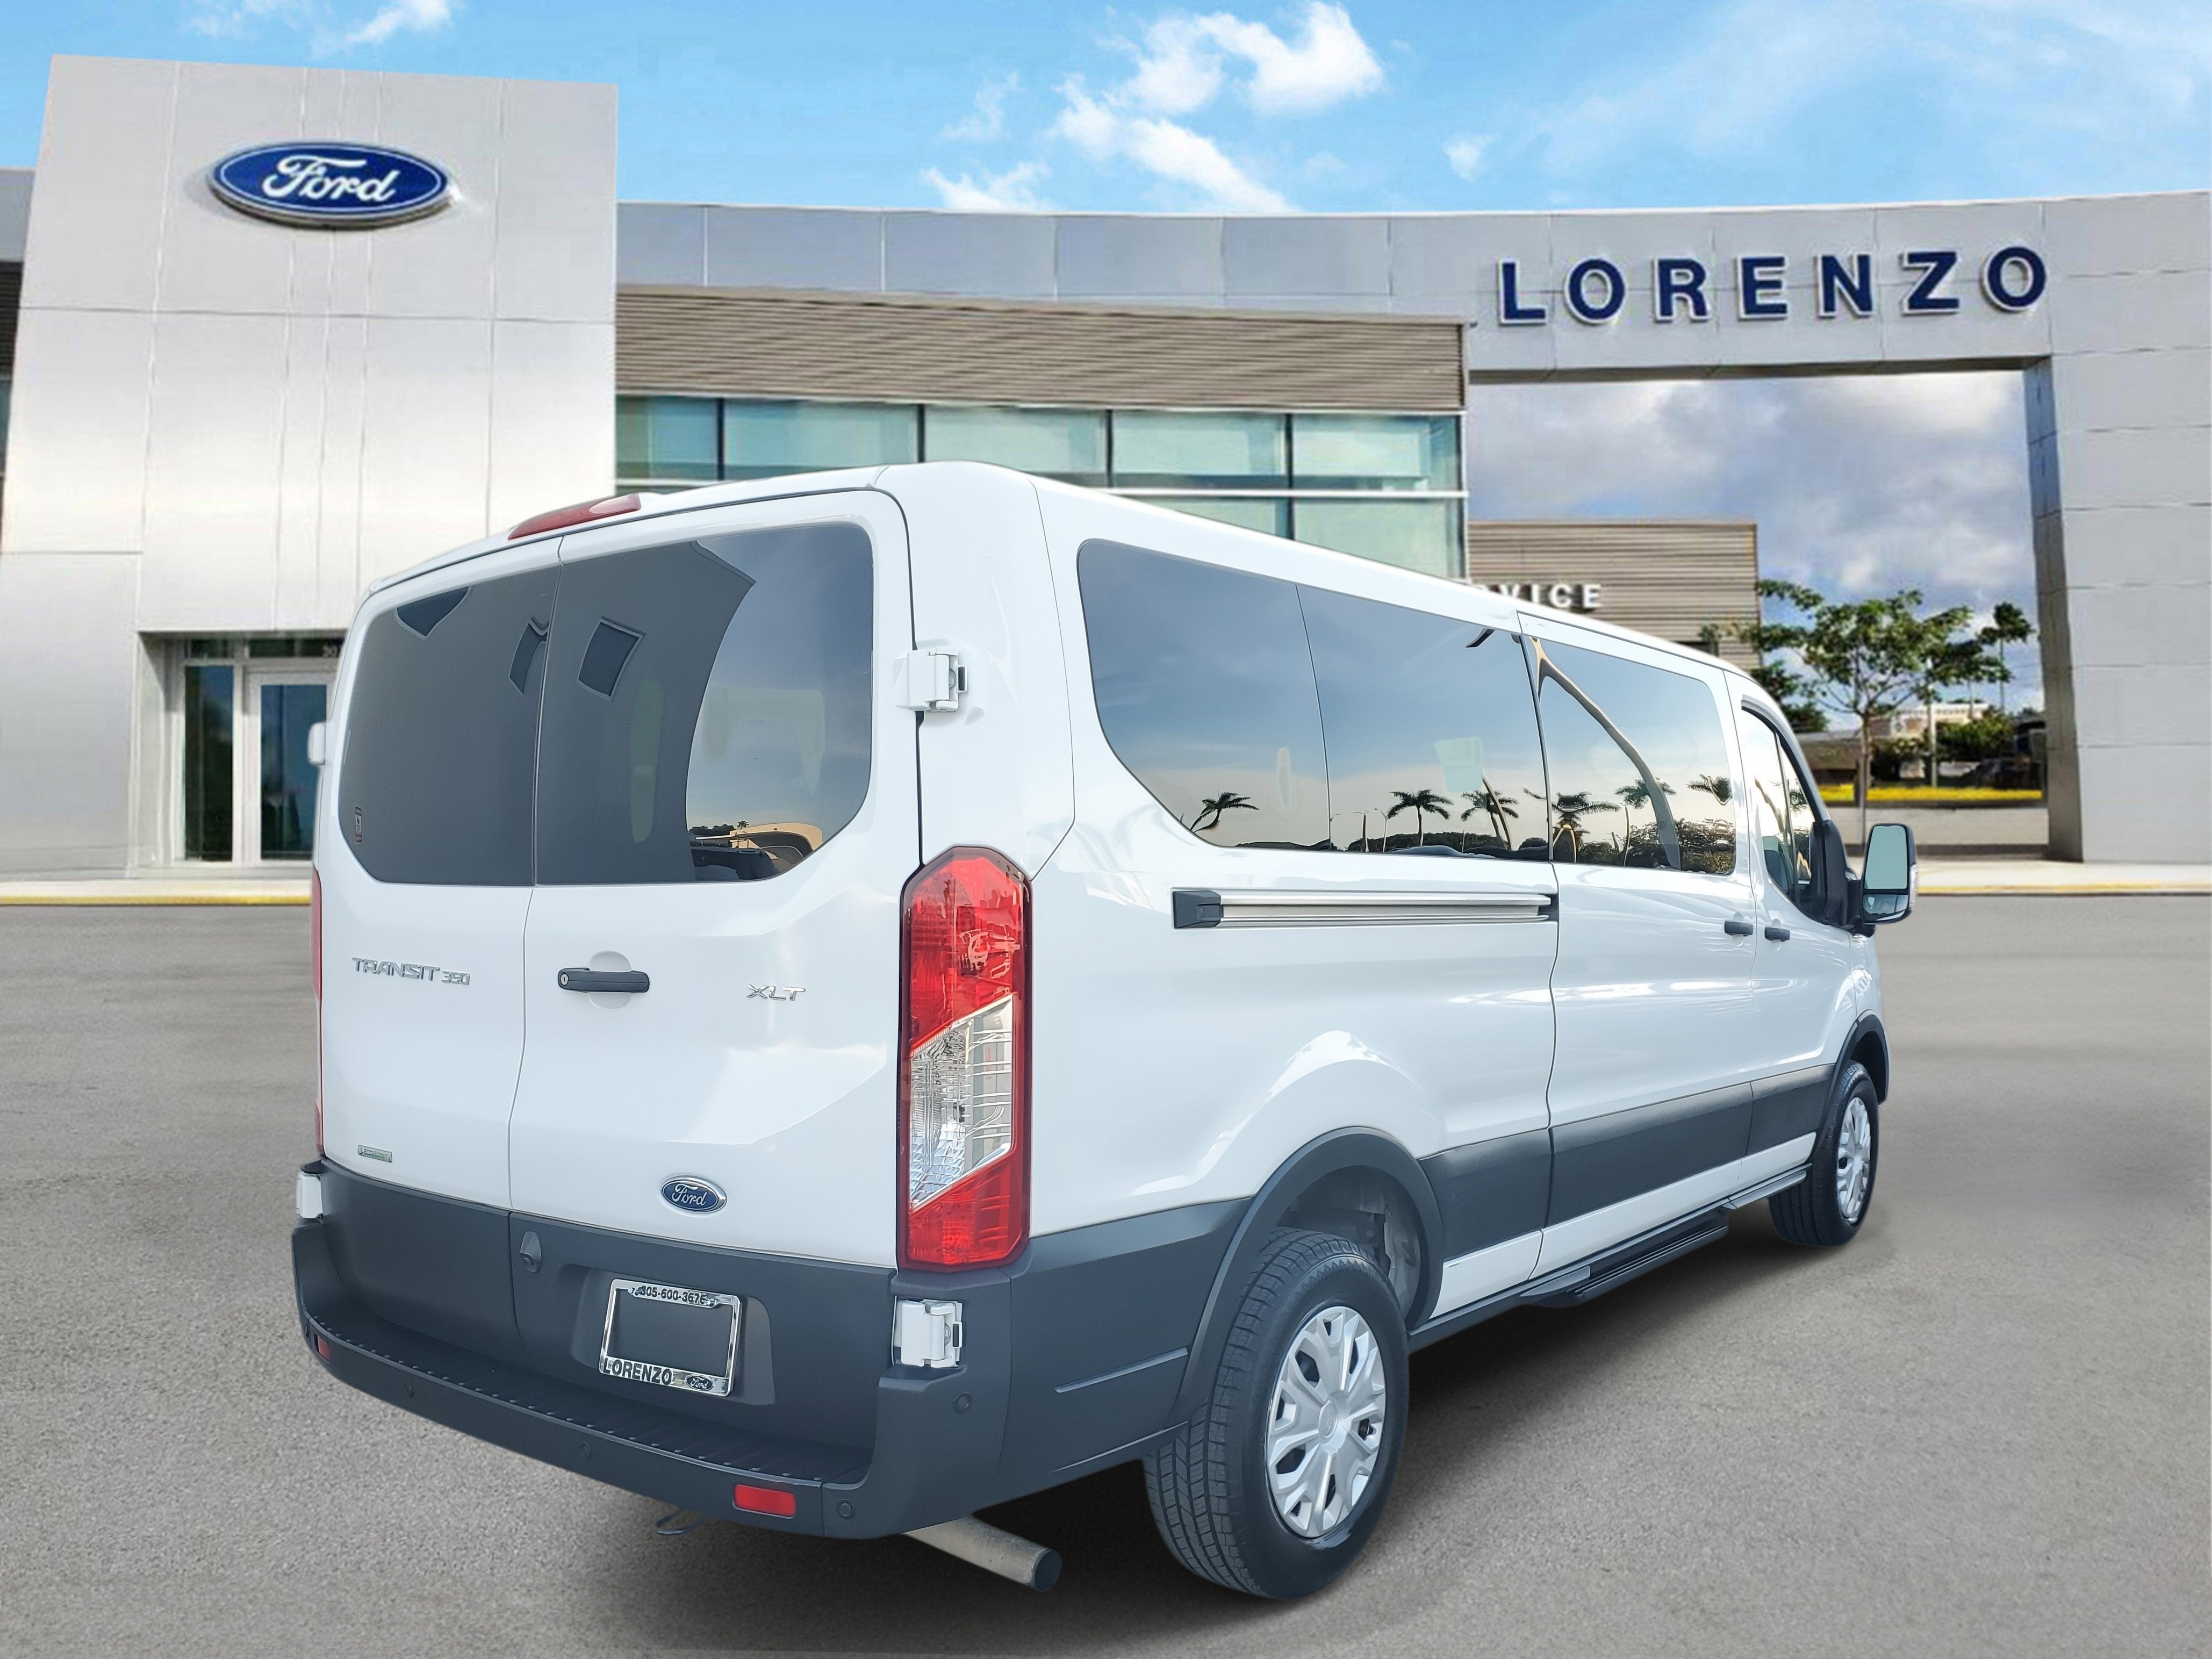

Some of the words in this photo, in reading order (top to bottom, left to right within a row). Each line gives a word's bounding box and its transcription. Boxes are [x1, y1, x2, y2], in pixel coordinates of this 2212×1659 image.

[262, 154, 402, 203] Ford
[1498, 246, 2047, 324] LORENZO
[1485, 584, 1602, 608] VICE
[352, 957, 440, 981] TRANSIT
[441, 971, 470, 985] 350
[746, 983, 806, 1001] XLT
[672, 1183, 707, 1205] Ford
[603, 1358, 672, 1385] LORENZO
[690, 1376, 709, 1389] Ford
